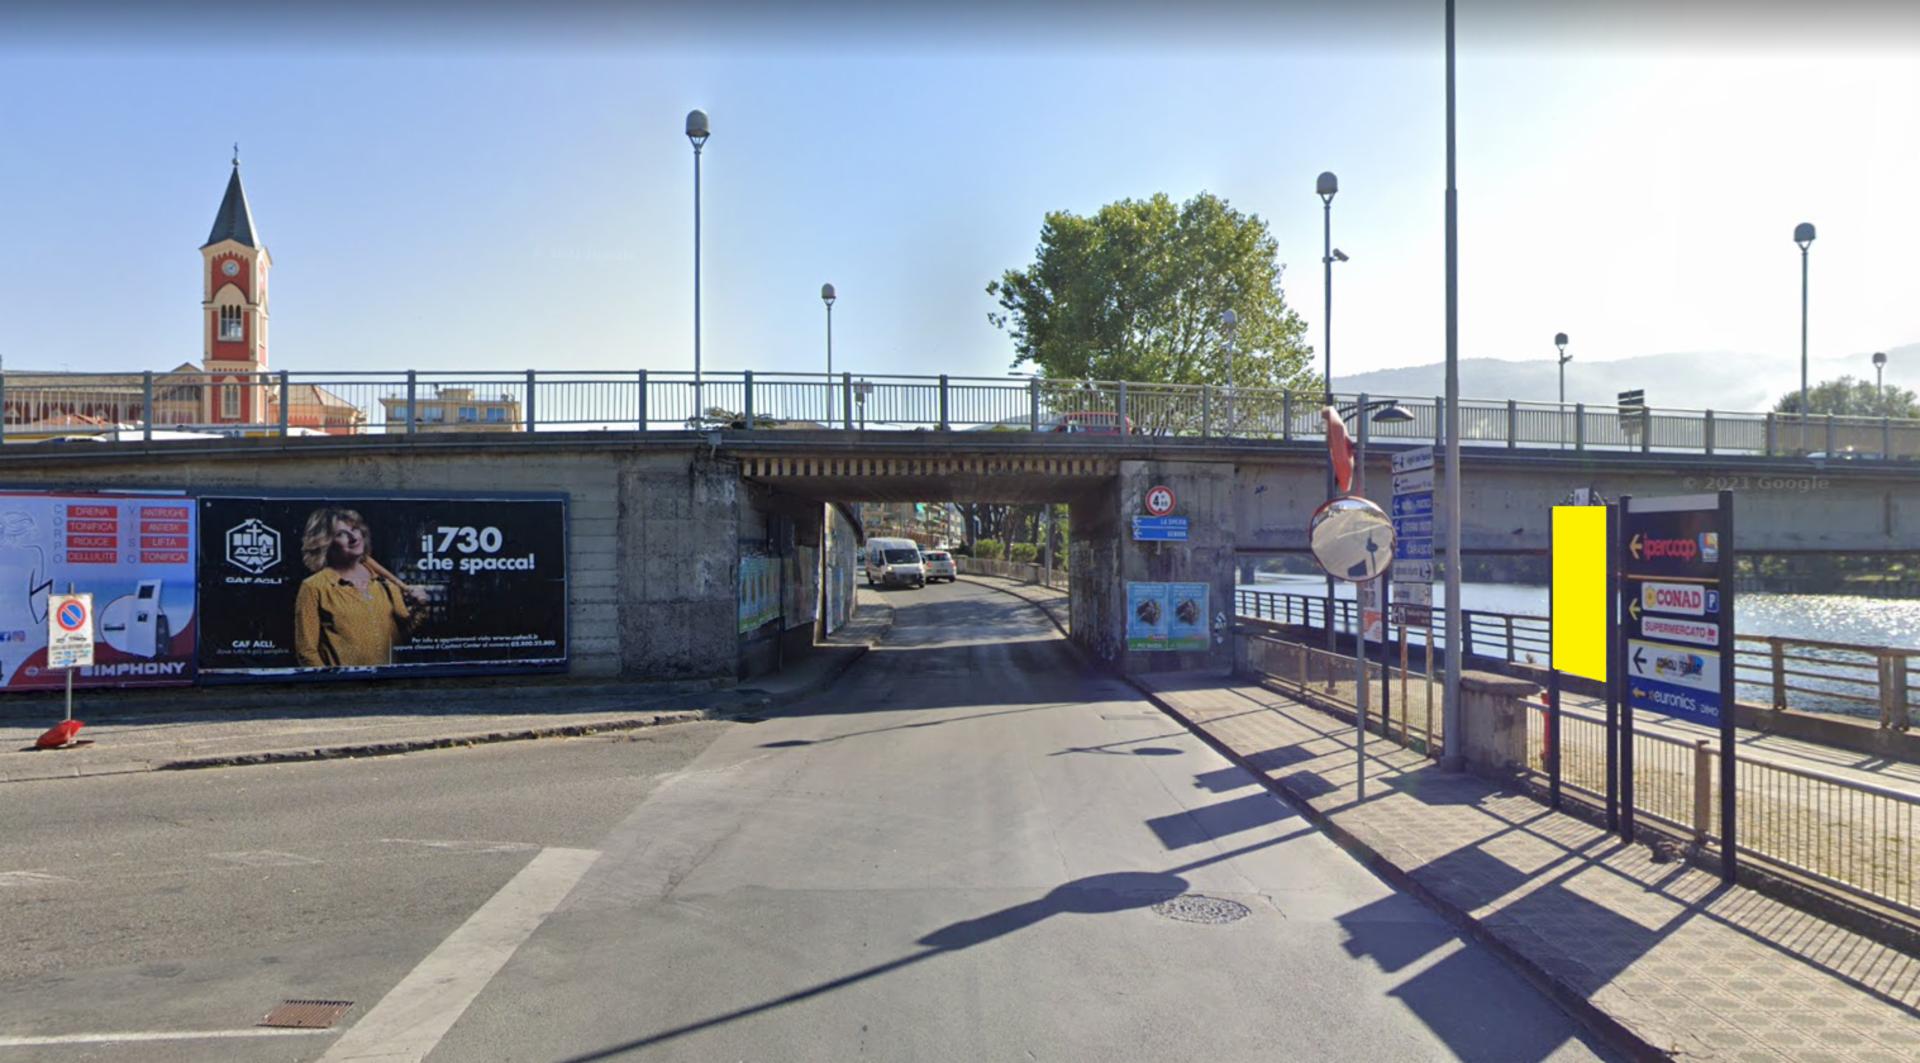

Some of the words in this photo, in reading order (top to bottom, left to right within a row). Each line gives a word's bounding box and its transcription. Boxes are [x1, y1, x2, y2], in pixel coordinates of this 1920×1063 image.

[75, 506, 110, 517] DRENA
[70, 522, 114, 532] TONIFICA
[73, 536, 110, 547] RIDUCE
[152, 537, 177, 547] LIFTA
[421, 534, 434, 553] il
[436, 526, 503, 553] 730
[68, 550, 114, 561] CELLULITE
[143, 551, 186, 562] TONIFICA
[417, 552, 454, 570] che
[459, 553, 535, 576] spacca!
[225, 576, 253, 584] CAF
[253, 577, 282, 585] ACLI
[1656, 588, 1702, 609] CONAD
[1644, 620, 1706, 639] SUPERMERCATO
[232, 640, 251, 648] CAF
[252, 640, 276, 649] ACLI,
[1653, 690, 1697, 712] euronics
